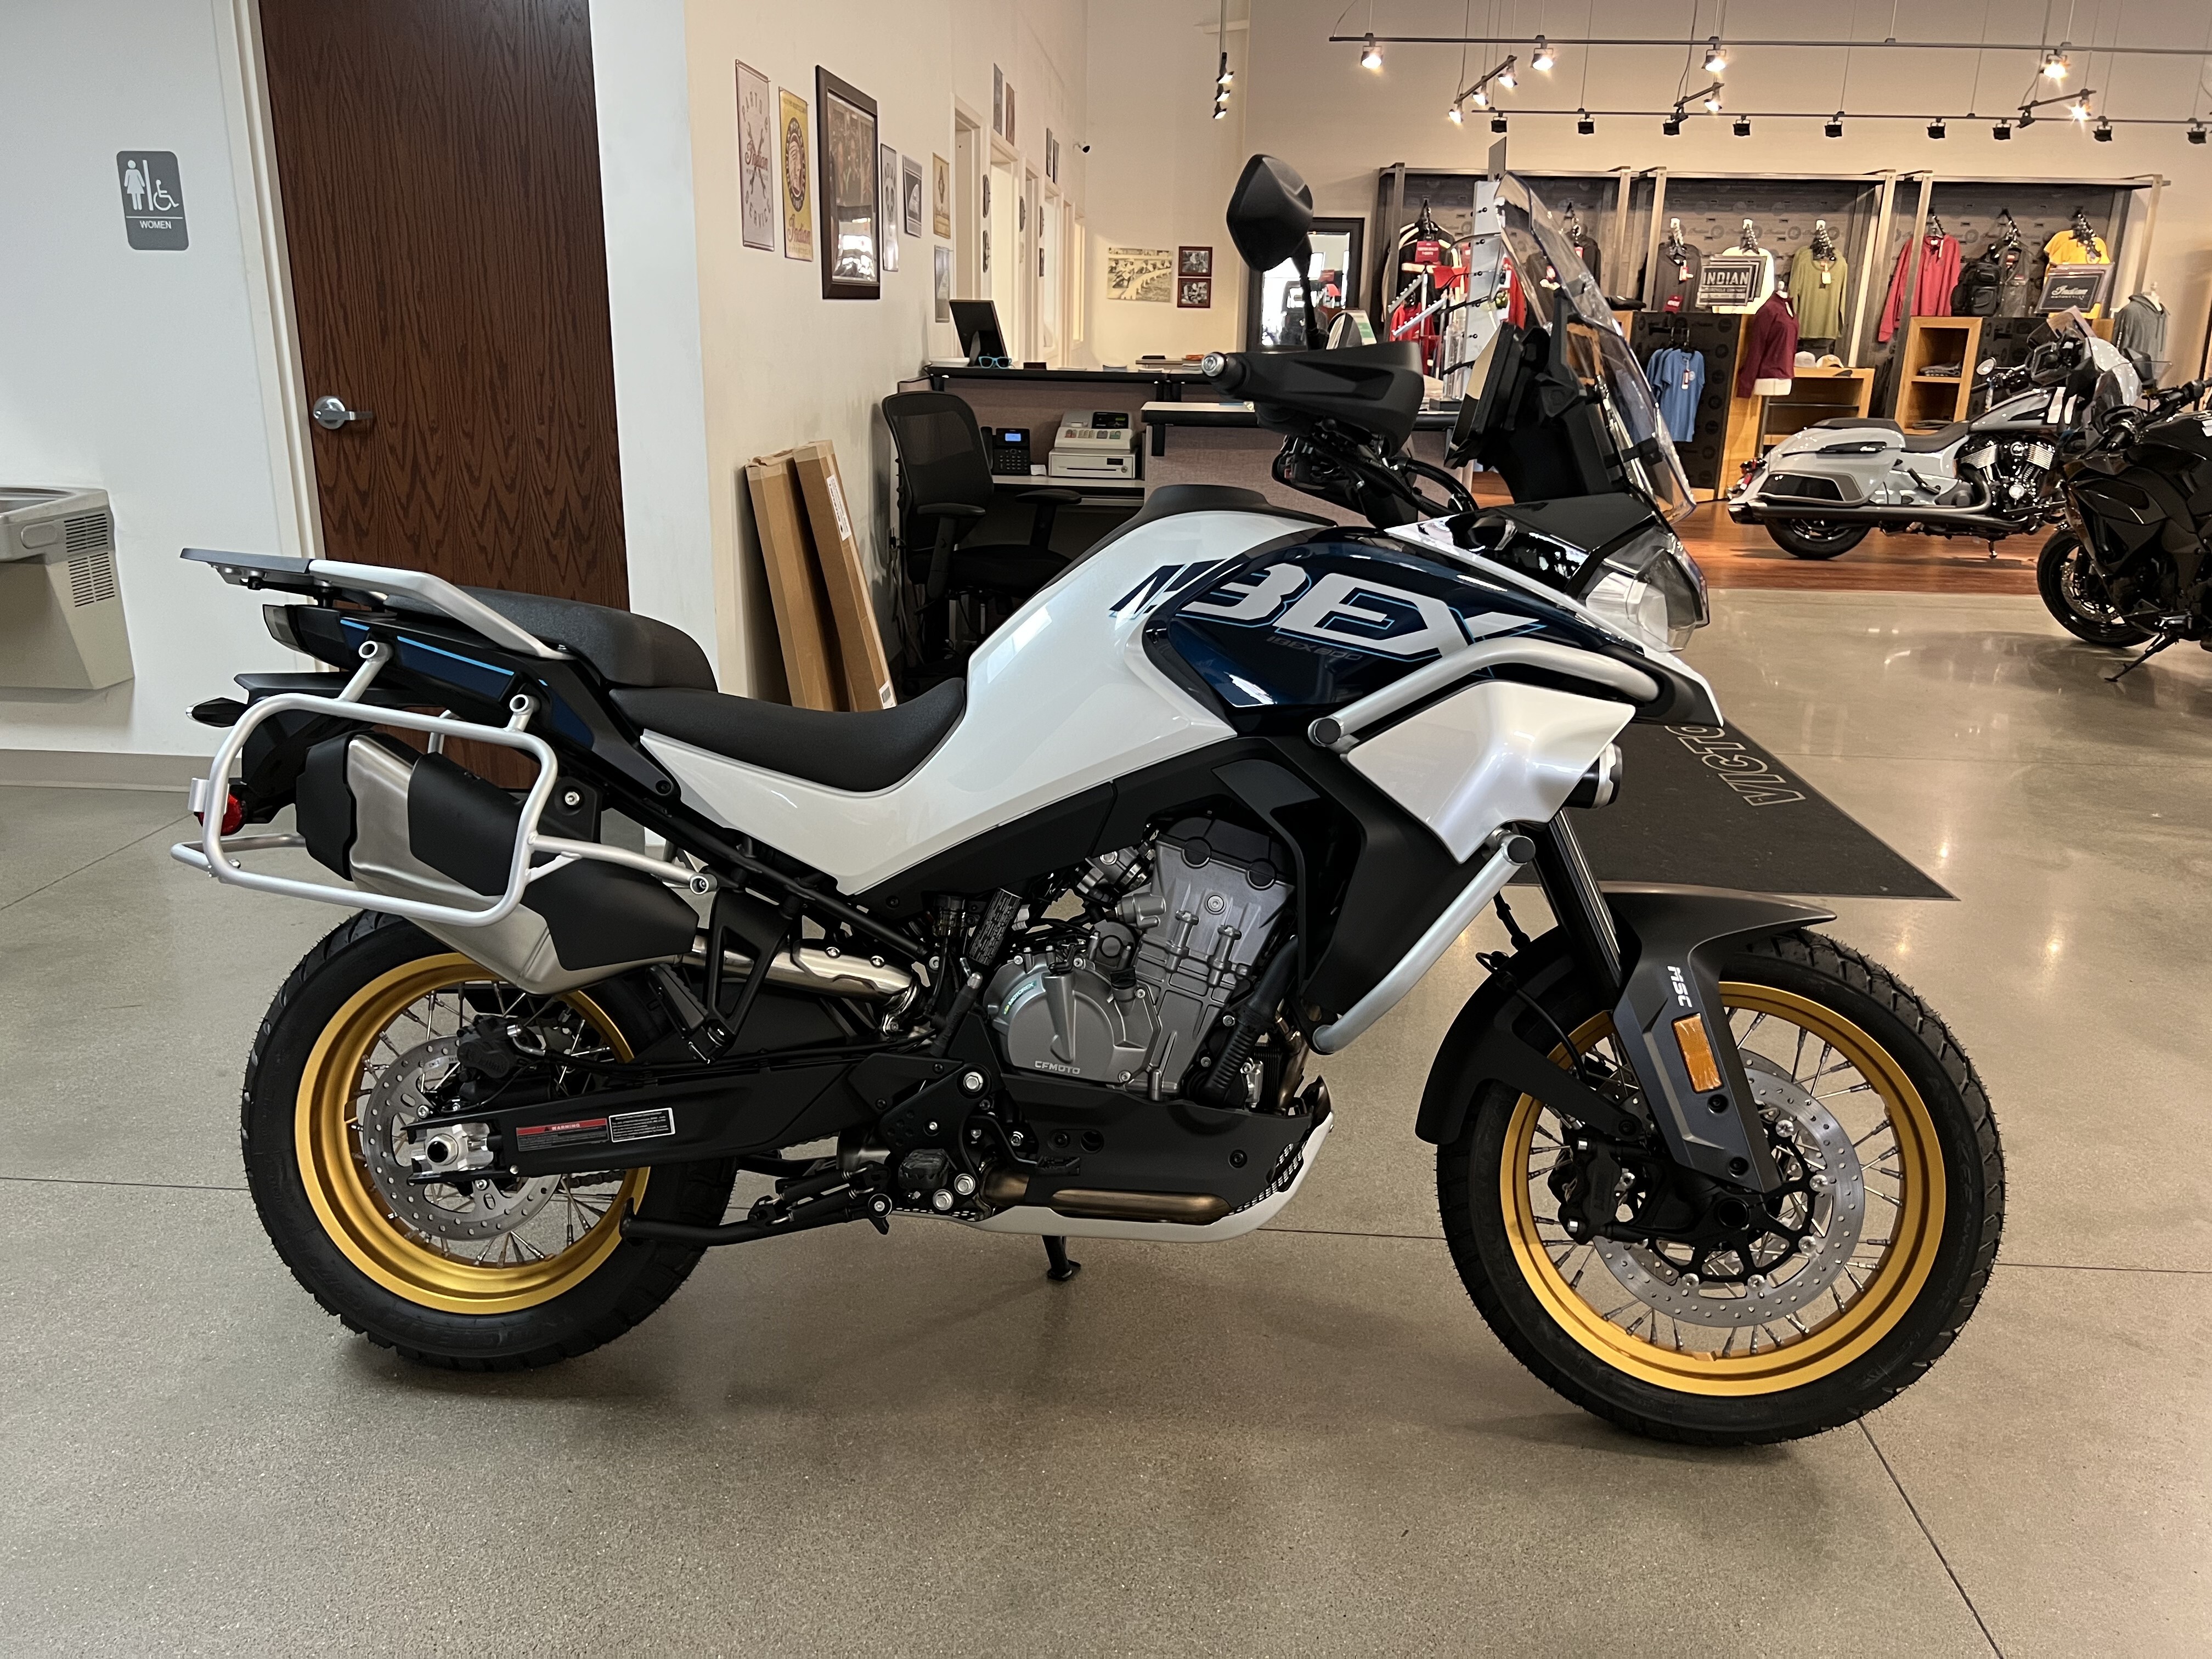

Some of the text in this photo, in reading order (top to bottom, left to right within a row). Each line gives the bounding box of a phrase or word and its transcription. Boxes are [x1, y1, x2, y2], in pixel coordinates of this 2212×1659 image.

[139, 221, 172, 229] WOMEN
[1703, 272, 1749, 285] INDIAN
[1266, 636, 1364, 661] IBEX 800
[1008, 983, 1034, 1006] MOTOREX
[1667, 966, 1692, 1008] MSC
[1035, 1060, 1081, 1075] CFMOTO
